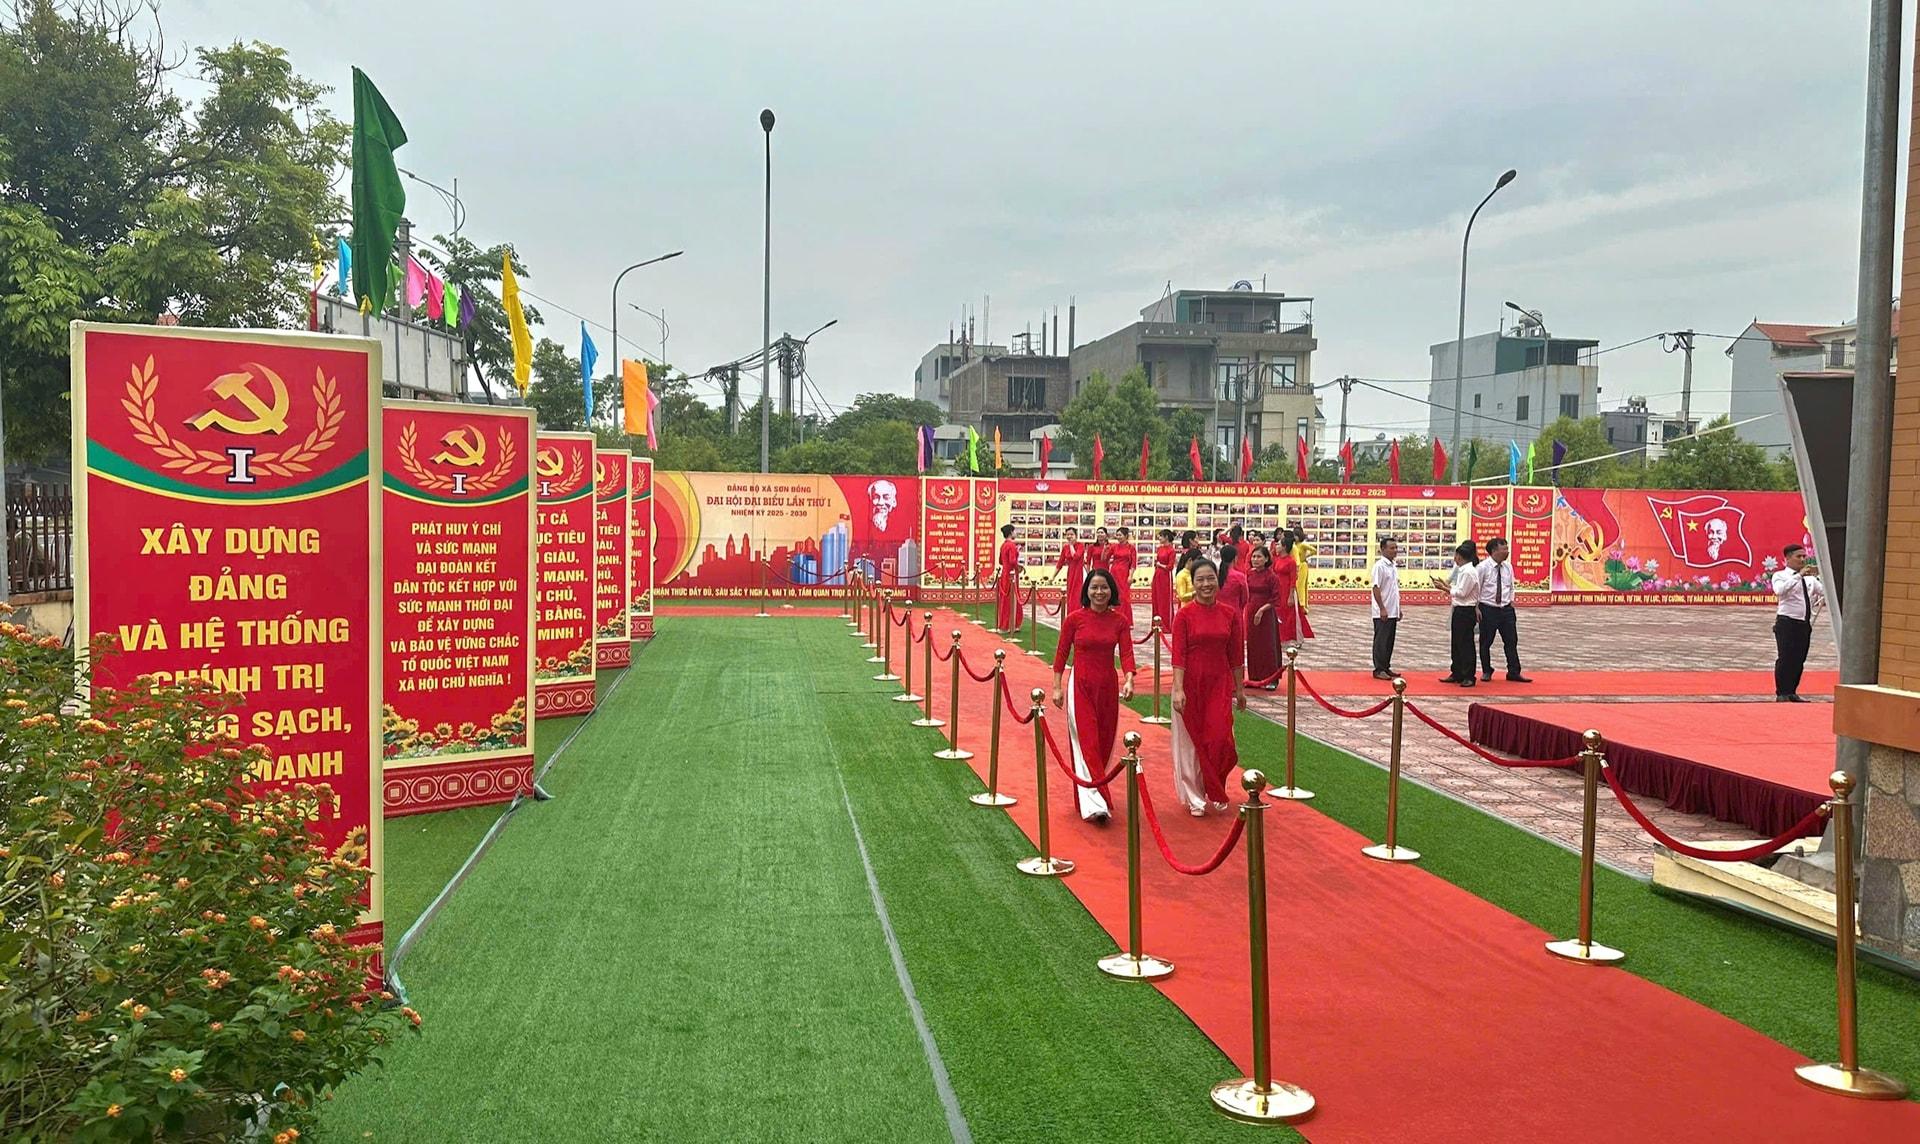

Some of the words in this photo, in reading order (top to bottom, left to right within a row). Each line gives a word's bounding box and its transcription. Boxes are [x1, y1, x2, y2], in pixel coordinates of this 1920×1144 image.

[227, 448, 254, 483] I
[452, 474, 467, 494] I
[727, 484, 748, 492] ĐẢNG
[750, 484, 760, 493] BỘ
[791, 485, 812, 493] ĐỒNG
[1086, 484, 1104, 493] MỘT
[1106, 483, 1117, 492] SỐ
[1118, 484, 1138, 494] HOẠT
[1140, 484, 1162, 494] ĐỘNG
[1164, 483, 1178, 492] NỔI
[1180, 484, 1194, 494] BẬT
[1197, 484, 1212, 494] CỦA
[1214, 484, 1236, 494] ĐẢNG
[1238, 486, 1248, 496] BỘ
[1250, 485, 1260, 494] XÃ
[1262, 486, 1278, 495] SƠN
[1280, 486, 1301, 495] ĐỒNG
[1303, 487, 1328, 496] NHIỆM
[1330, 487, 1341, 496] KỲ
[1368, 488, 1386, 496] 2025
[706, 497, 724, 507] ĐẠI
[726, 494, 742, 508] HỘI
[744, 497, 761, 508] ĐẠI
[763, 493, 784, 506] BIỂU
[786, 495, 805, 506] LẦN
[806, 496, 826, 507] THỨ
[828, 498, 831, 507] I
[550, 509, 568, 525] CẢ
[731, 508, 754, 517] NHIỆM
[756, 508, 765, 516] KỲ
[412, 521, 442, 535] PHÁT
[446, 522, 468, 535] HUY
[472, 521, 479, 535] Ý
[482, 521, 502, 535] CHÍ
[599, 524, 620, 535] TIÊU
[140, 522, 214, 554] XÂY
[226, 525, 320, 560] DỰNG
[536, 532, 552, 546] ỤC
[556, 530, 586, 544] TIÊU
[416, 540, 432, 555] VÀ
[435, 540, 458, 554] SỨC
[462, 542, 497, 556] MẠNH
[416, 561, 436, 576] ĐẠI
[440, 560, 472, 574] ĐOÀN
[476, 558, 496, 573] KẾT
[597, 555, 622, 568] ẠNH,
[598, 568, 614, 580] HỦ,
[189, 566, 287, 602] ĐẢNG
[394, 580, 419, 594] DÂN
[422, 579, 445, 596] TỘC
[448, 577, 469, 592] KẾT
[472, 580, 496, 594] HỢP
[499, 578, 517, 592] VỚI
[598, 582, 620, 594] ẰNG,
[750, 588, 770, 597] NGHA,
[398, 599, 422, 614] SỨC
[426, 600, 462, 614] MẠNH
[465, 597, 490, 612] THỜI
[494, 599, 512, 612] ĐẠI
[119, 618, 167, 651] VÀ
[180, 616, 225, 654] HỆ
[237, 610, 350, 646] THỐNG
[418, 615, 433, 632] ĐỂ
[436, 617, 459, 631] XÂY
[463, 618, 494, 633] DỰNG
[390, 638, 406, 653] VÀ
[410, 636, 434, 652] BẢO
[438, 636, 452, 652] VỆ
[455, 636, 486, 650] VỮNG
[489, 632, 520, 648] CHẮC
[538, 627, 574, 641] MINH
[402, 655, 416, 672] TỔ
[420, 654, 452, 672] QUỐC
[455, 654, 480, 670] VIỆT
[482, 655, 509, 667] NAM
[273, 663, 324, 694] TRỊ
[398, 677, 415, 692] XÃ
[418, 676, 438, 692] HỘI
[442, 672, 466, 688] CHỦ
[468, 672, 504, 688] NGHĨA
[251, 706, 352, 740] SẠCH,
[242, 750, 343, 786] MẠNH
